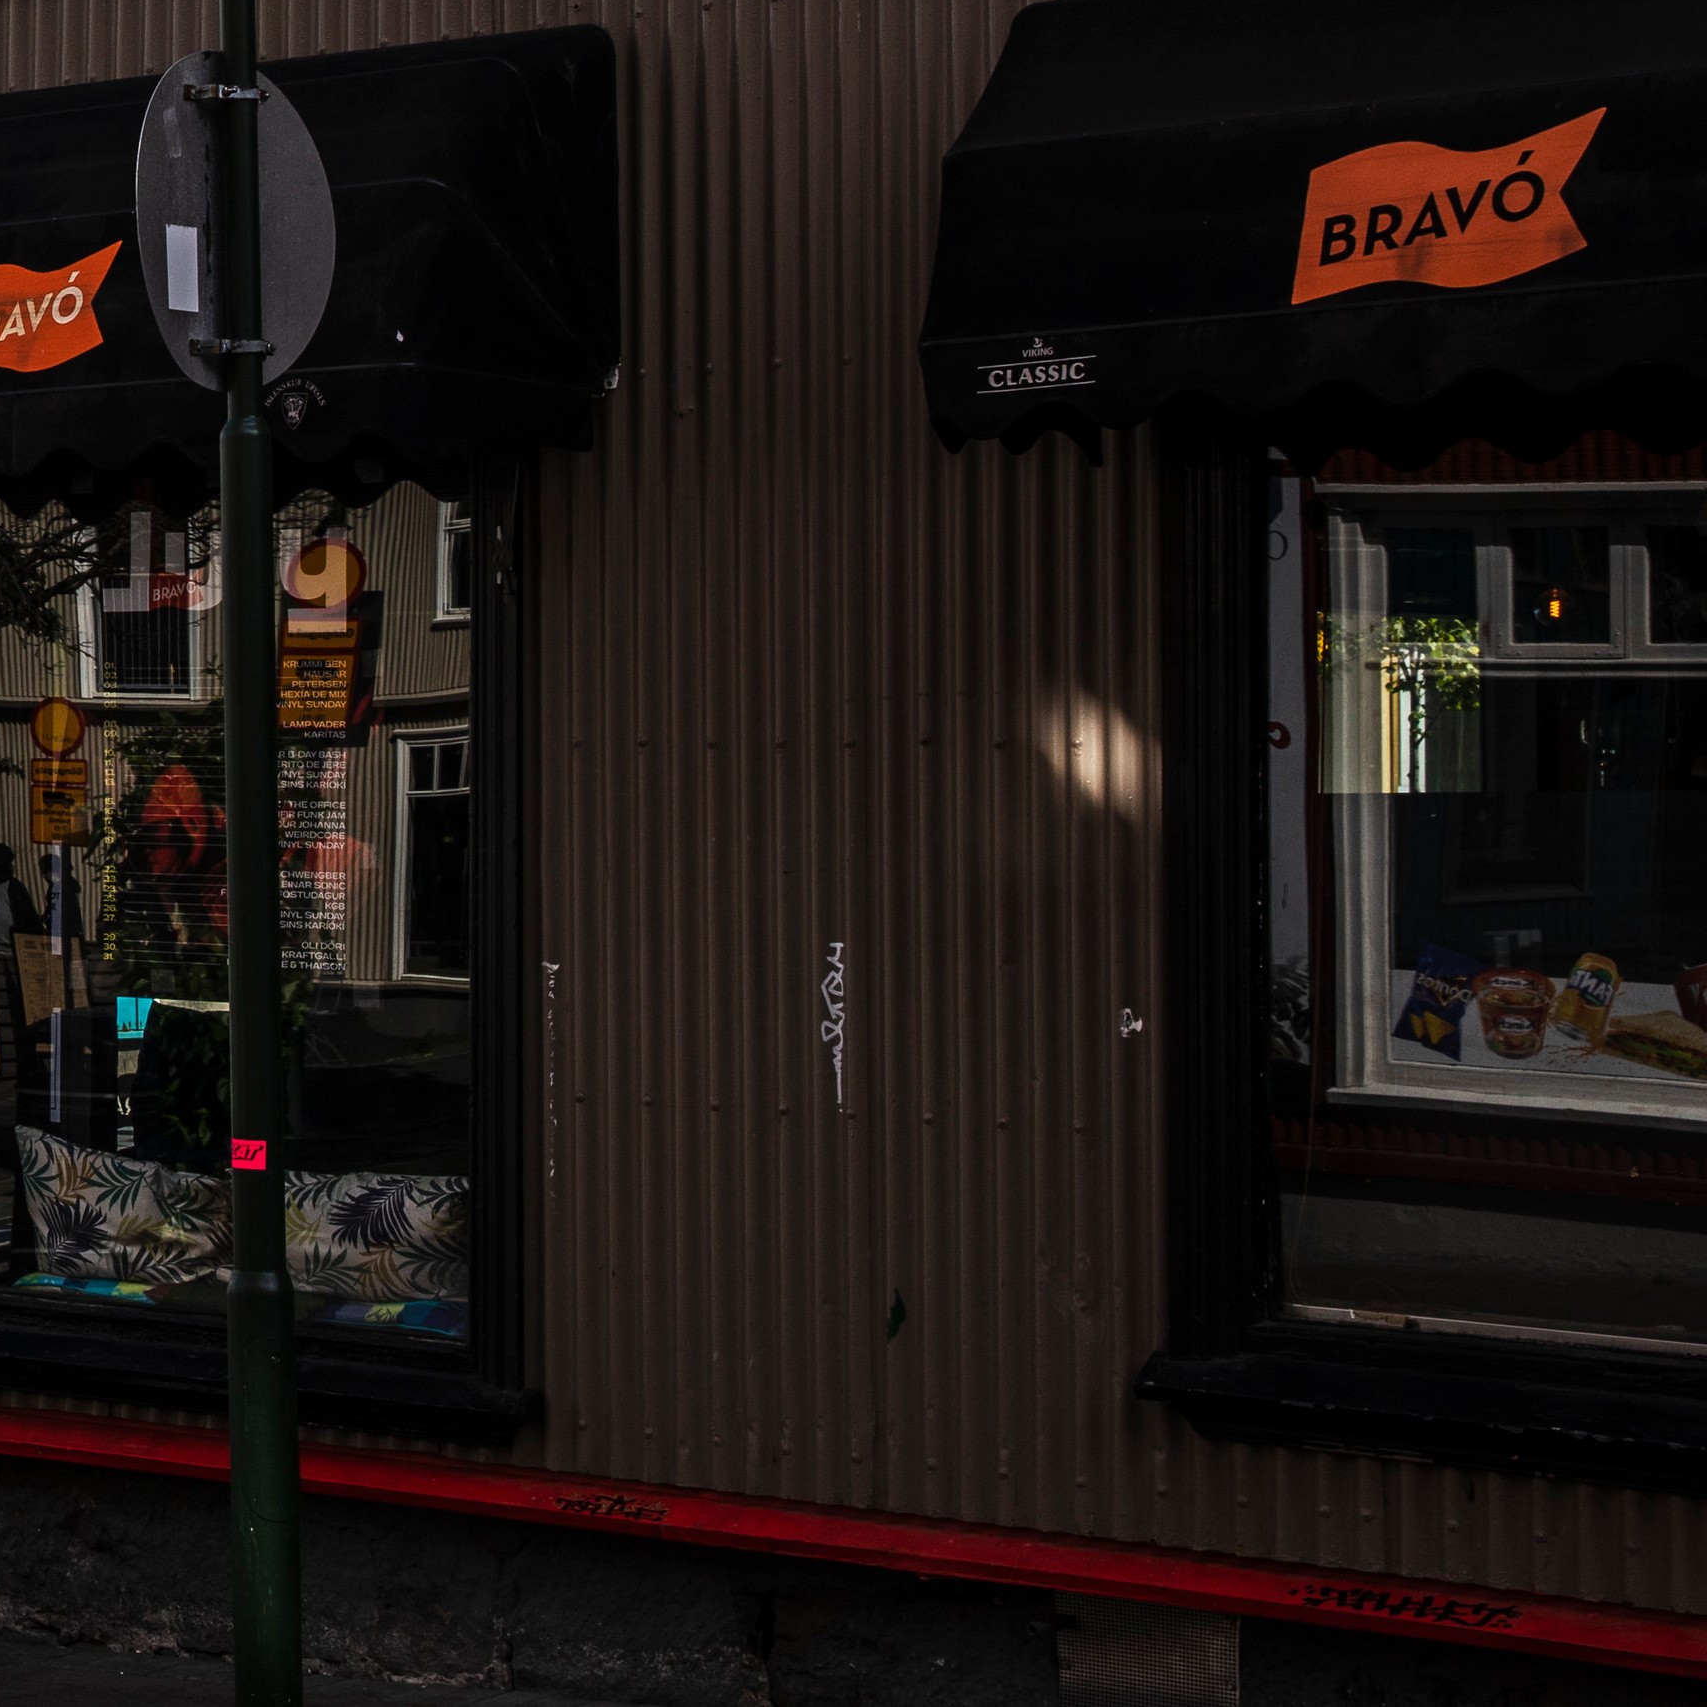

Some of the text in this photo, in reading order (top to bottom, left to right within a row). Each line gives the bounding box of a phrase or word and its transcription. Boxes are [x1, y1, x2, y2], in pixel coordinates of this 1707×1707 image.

[1319, 150, 1545, 267] BRAVÓ
[988, 362, 1086, 388] CLASSIC
[292, 680, 347, 688] PETERSEN
[312, 690, 327, 698] DE
[329, 690, 347, 698] MIX
[306, 700, 347, 709] SUNDAY
[313, 721, 347, 729] VADER
[319, 751, 347, 760] BASH
[306, 760, 320, 769] DE
[306, 771, 347, 780] SUNDAY
[309, 801, 347, 810] OFFICE
[297, 811, 325, 819] FUNK
[326, 811, 347, 820] JAM
[298, 821, 346, 830] JOHANNA
[284, 831, 346, 840] WEIRDCORE
[305, 841, 346, 850] SUNDAY
[280, 870, 346, 880] CHWENGBER
[281, 880, 312, 889] EINAR
[313, 881, 346, 891] SONIC
[324, 901, 346, 911] KGB
[280, 910, 303, 919] INYL
[304, 911, 345, 921] SUNDAY
[281, 950, 346, 961] KRAFTGALLI
[298, 961, 346, 971] THAISON
